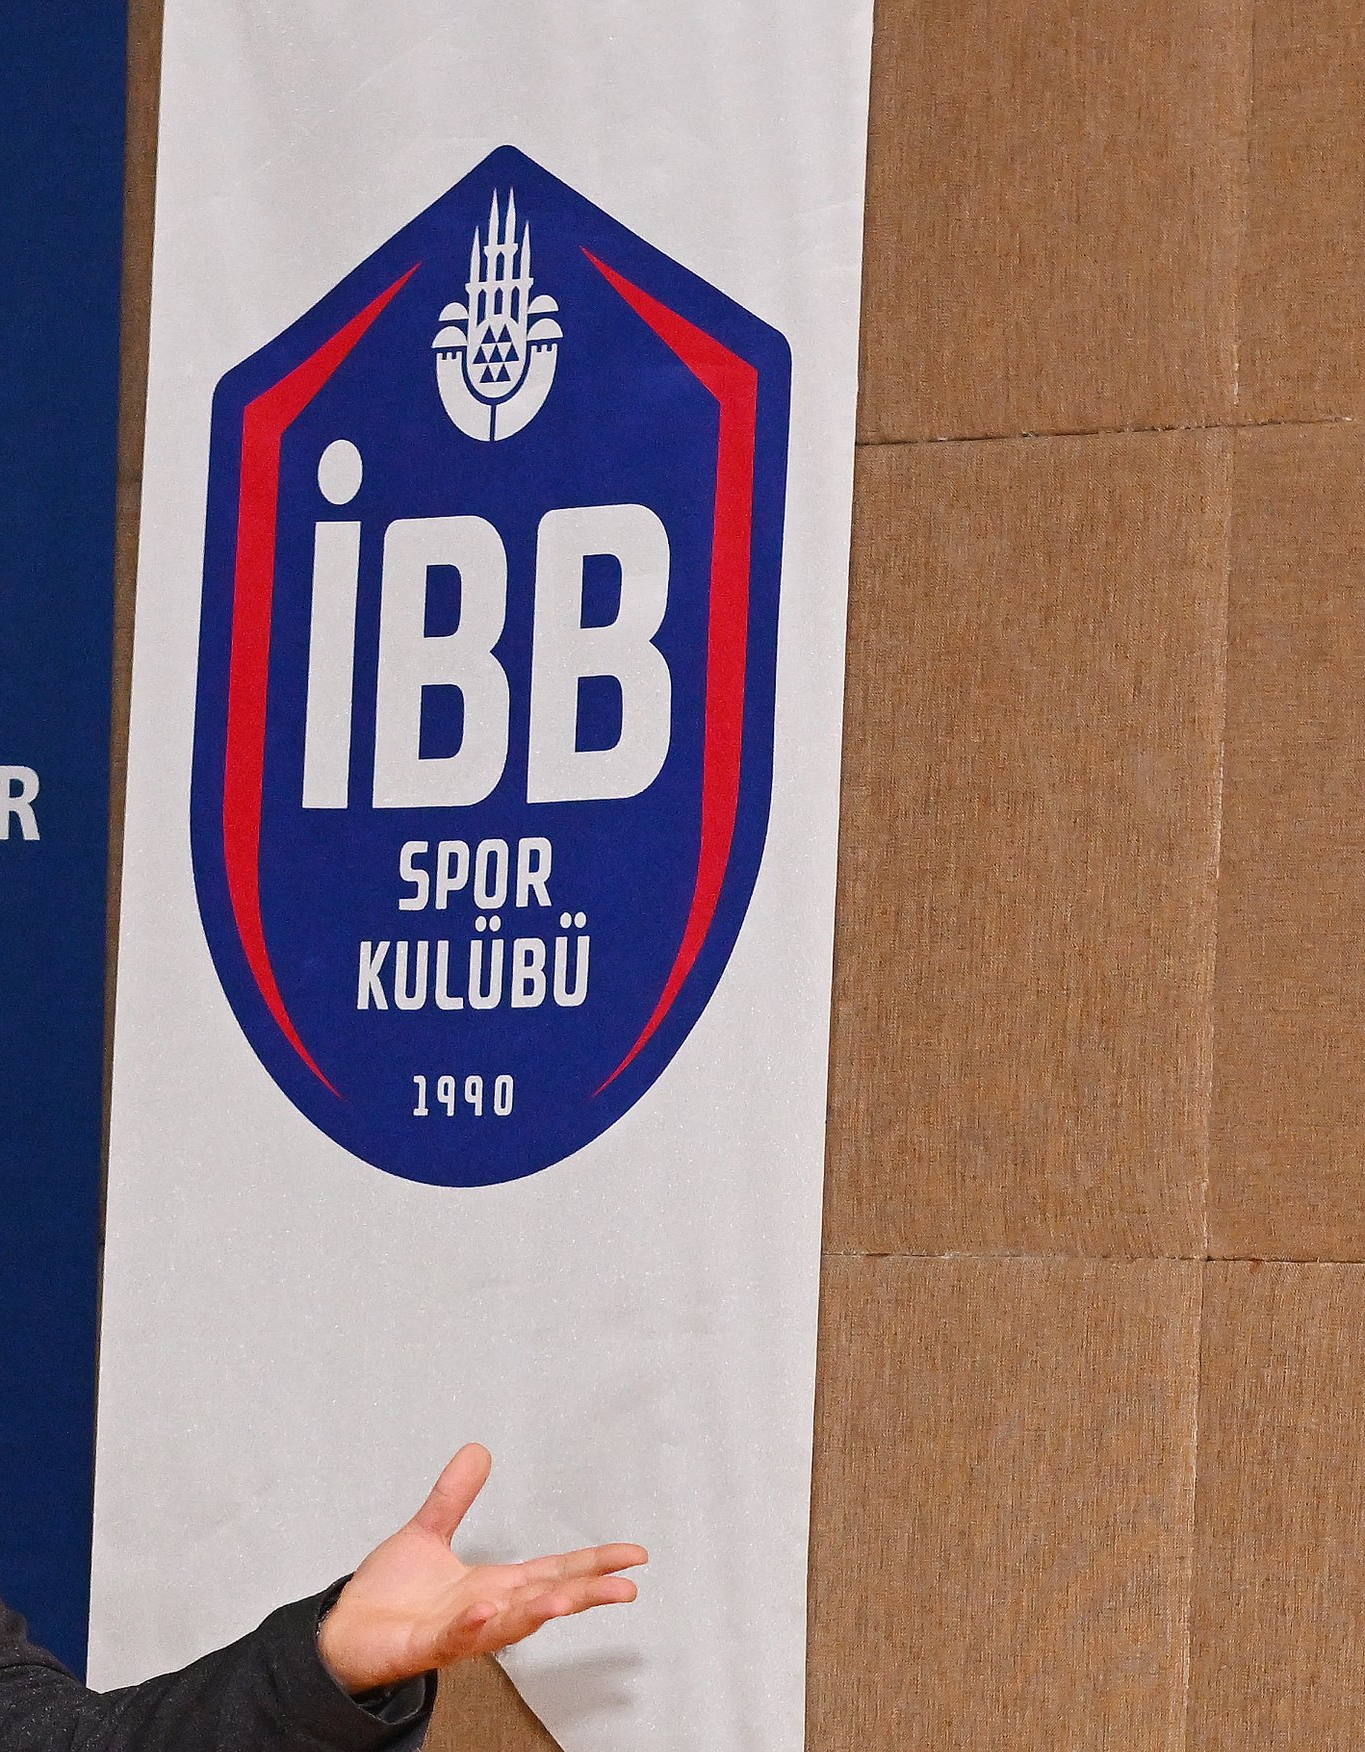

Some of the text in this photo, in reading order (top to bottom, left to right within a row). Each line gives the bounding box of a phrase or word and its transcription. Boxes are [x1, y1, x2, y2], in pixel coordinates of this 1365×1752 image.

[301, 438, 672, 811] İBB
[397, 835, 554, 912] SPOR
[356, 913, 591, 1012] KULÜBÜ
[412, 1073, 515, 1119] 1990
